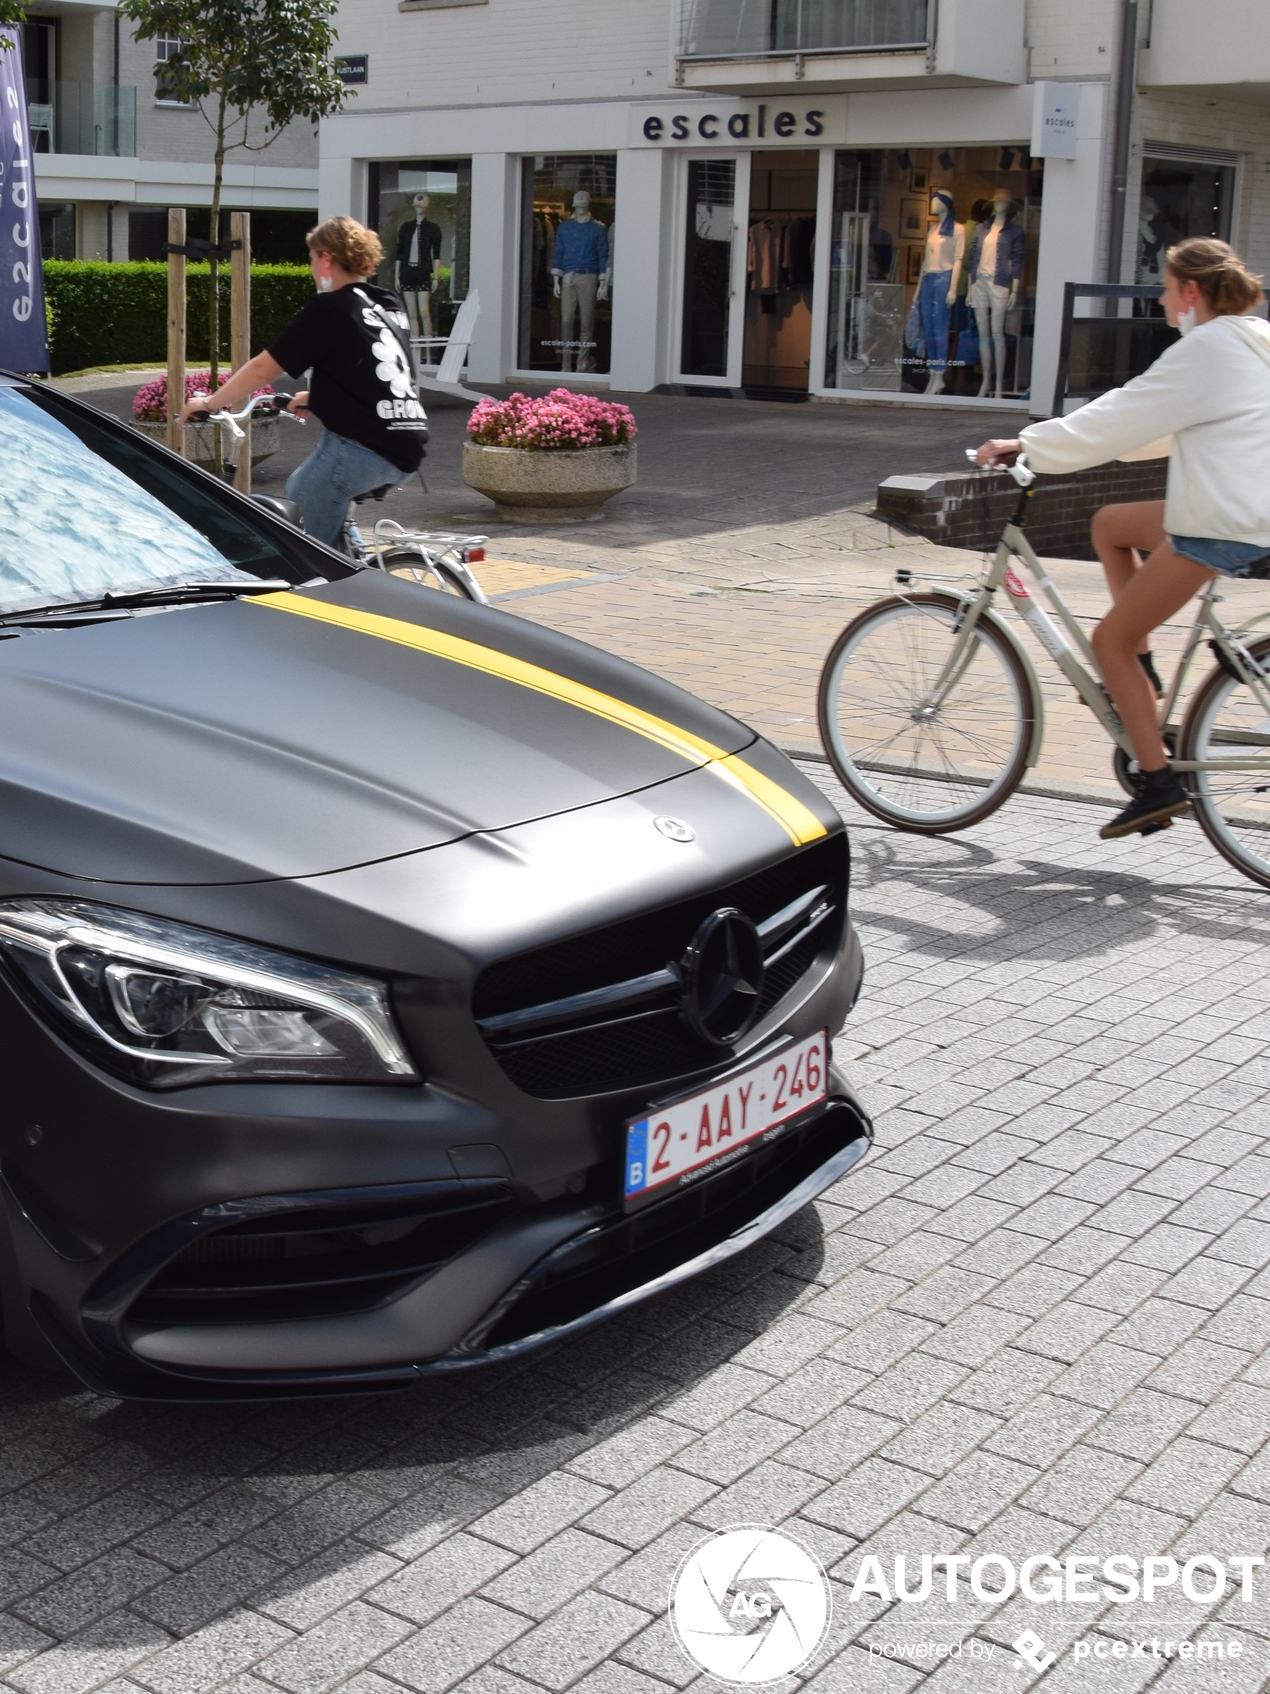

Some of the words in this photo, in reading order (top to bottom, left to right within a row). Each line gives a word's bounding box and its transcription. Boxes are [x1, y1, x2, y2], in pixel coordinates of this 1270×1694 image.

[643, 104, 825, 141] escales
[1045, 117, 1075, 128] escales
[541, 340, 597, 348] escales-paris.com
[894, 357, 966, 367] escales-paris.com
[651, 1044, 821, 1174] 2-AAY-246
[630, 1161, 644, 1186] B
